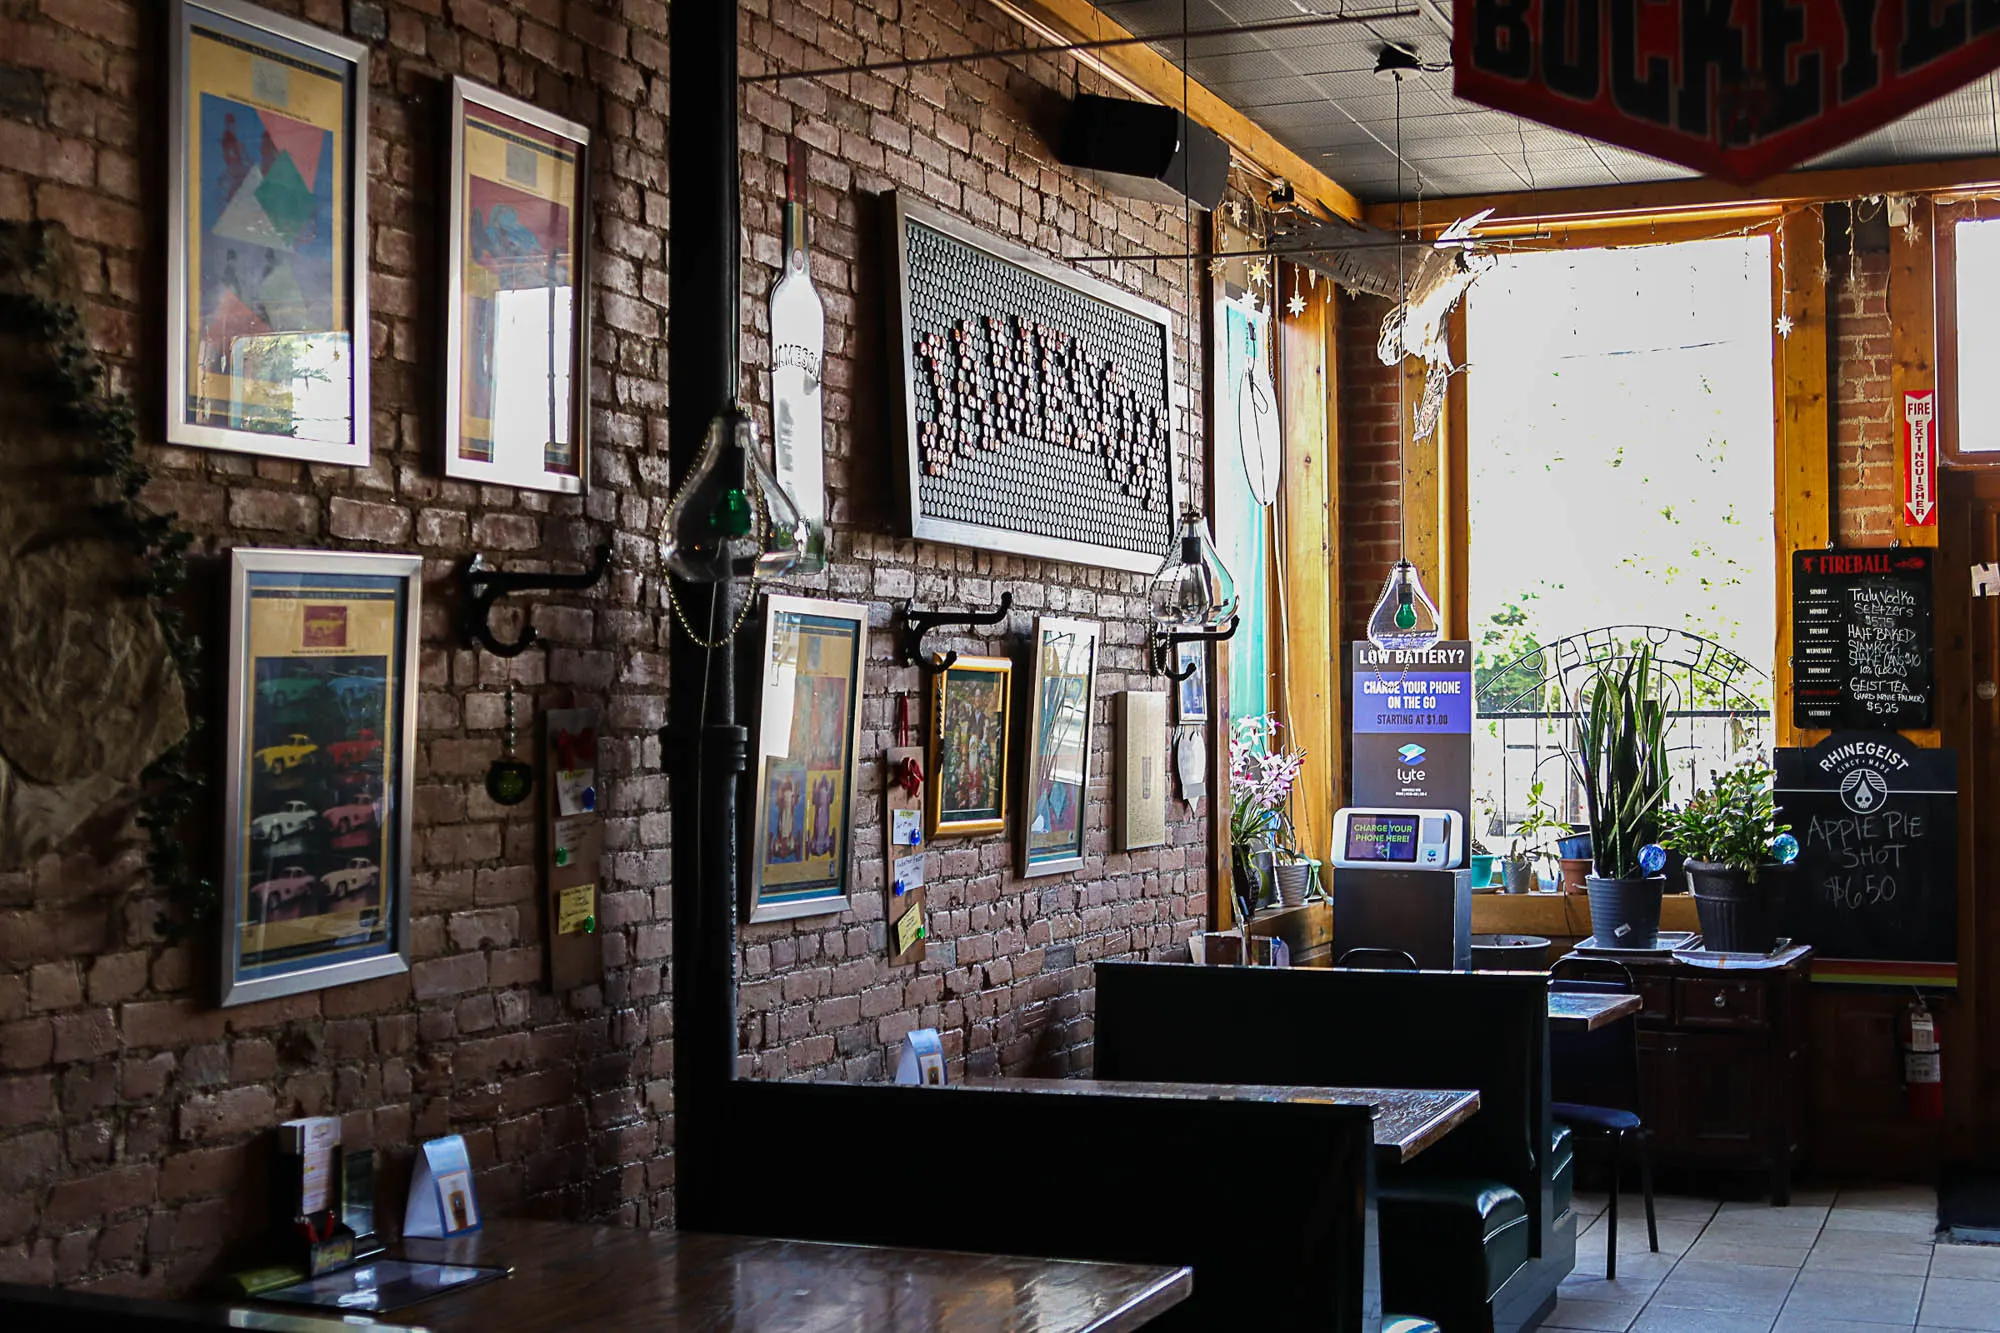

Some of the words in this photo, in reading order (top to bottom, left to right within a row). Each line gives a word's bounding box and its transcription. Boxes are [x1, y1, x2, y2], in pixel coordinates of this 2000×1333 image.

[773, 343, 821, 383] JAMESON
[1907, 402, 1930, 415] FIRE
[1914, 420, 1925, 516] EXTINGUISHER
[1819, 554, 1892, 575] FIREBALL
[1847, 587, 1880, 608] Truly
[1872, 627, 1916, 643] BAKED
[1359, 649, 1390, 664] LOW
[1395, 649, 1465, 664] BATTERY?
[1363, 681, 1400, 694] CHARGE
[1401, 681, 1427, 694] YOUR
[1429, 681, 1461, 694] PHONE
[1849, 677, 1886, 693] GEIST
[1886, 679, 1910, 693] TEA
[1387, 696, 1402, 709] ON
[1403, 696, 1421, 709] THE
[1423, 696, 1436, 709] GO
[1377, 714, 1413, 725] STARTING
[1415, 714, 1425, 725] AT
[1819, 742, 1909, 772] RHINEGEIST
[1836, 758, 1860, 774] CINCY
[1396, 768, 1426, 785] lyte
[1353, 824, 1388, 833] CHARGE
[1389, 824, 1413, 833] YOUR
[1806, 815, 1879, 850] APPLE
[1882, 810, 1924, 839] PIE
[1355, 834, 1385, 842] PHONE
[1385, 835, 1410, 843] HERE!
[1842, 844, 1908, 869] SHOT
